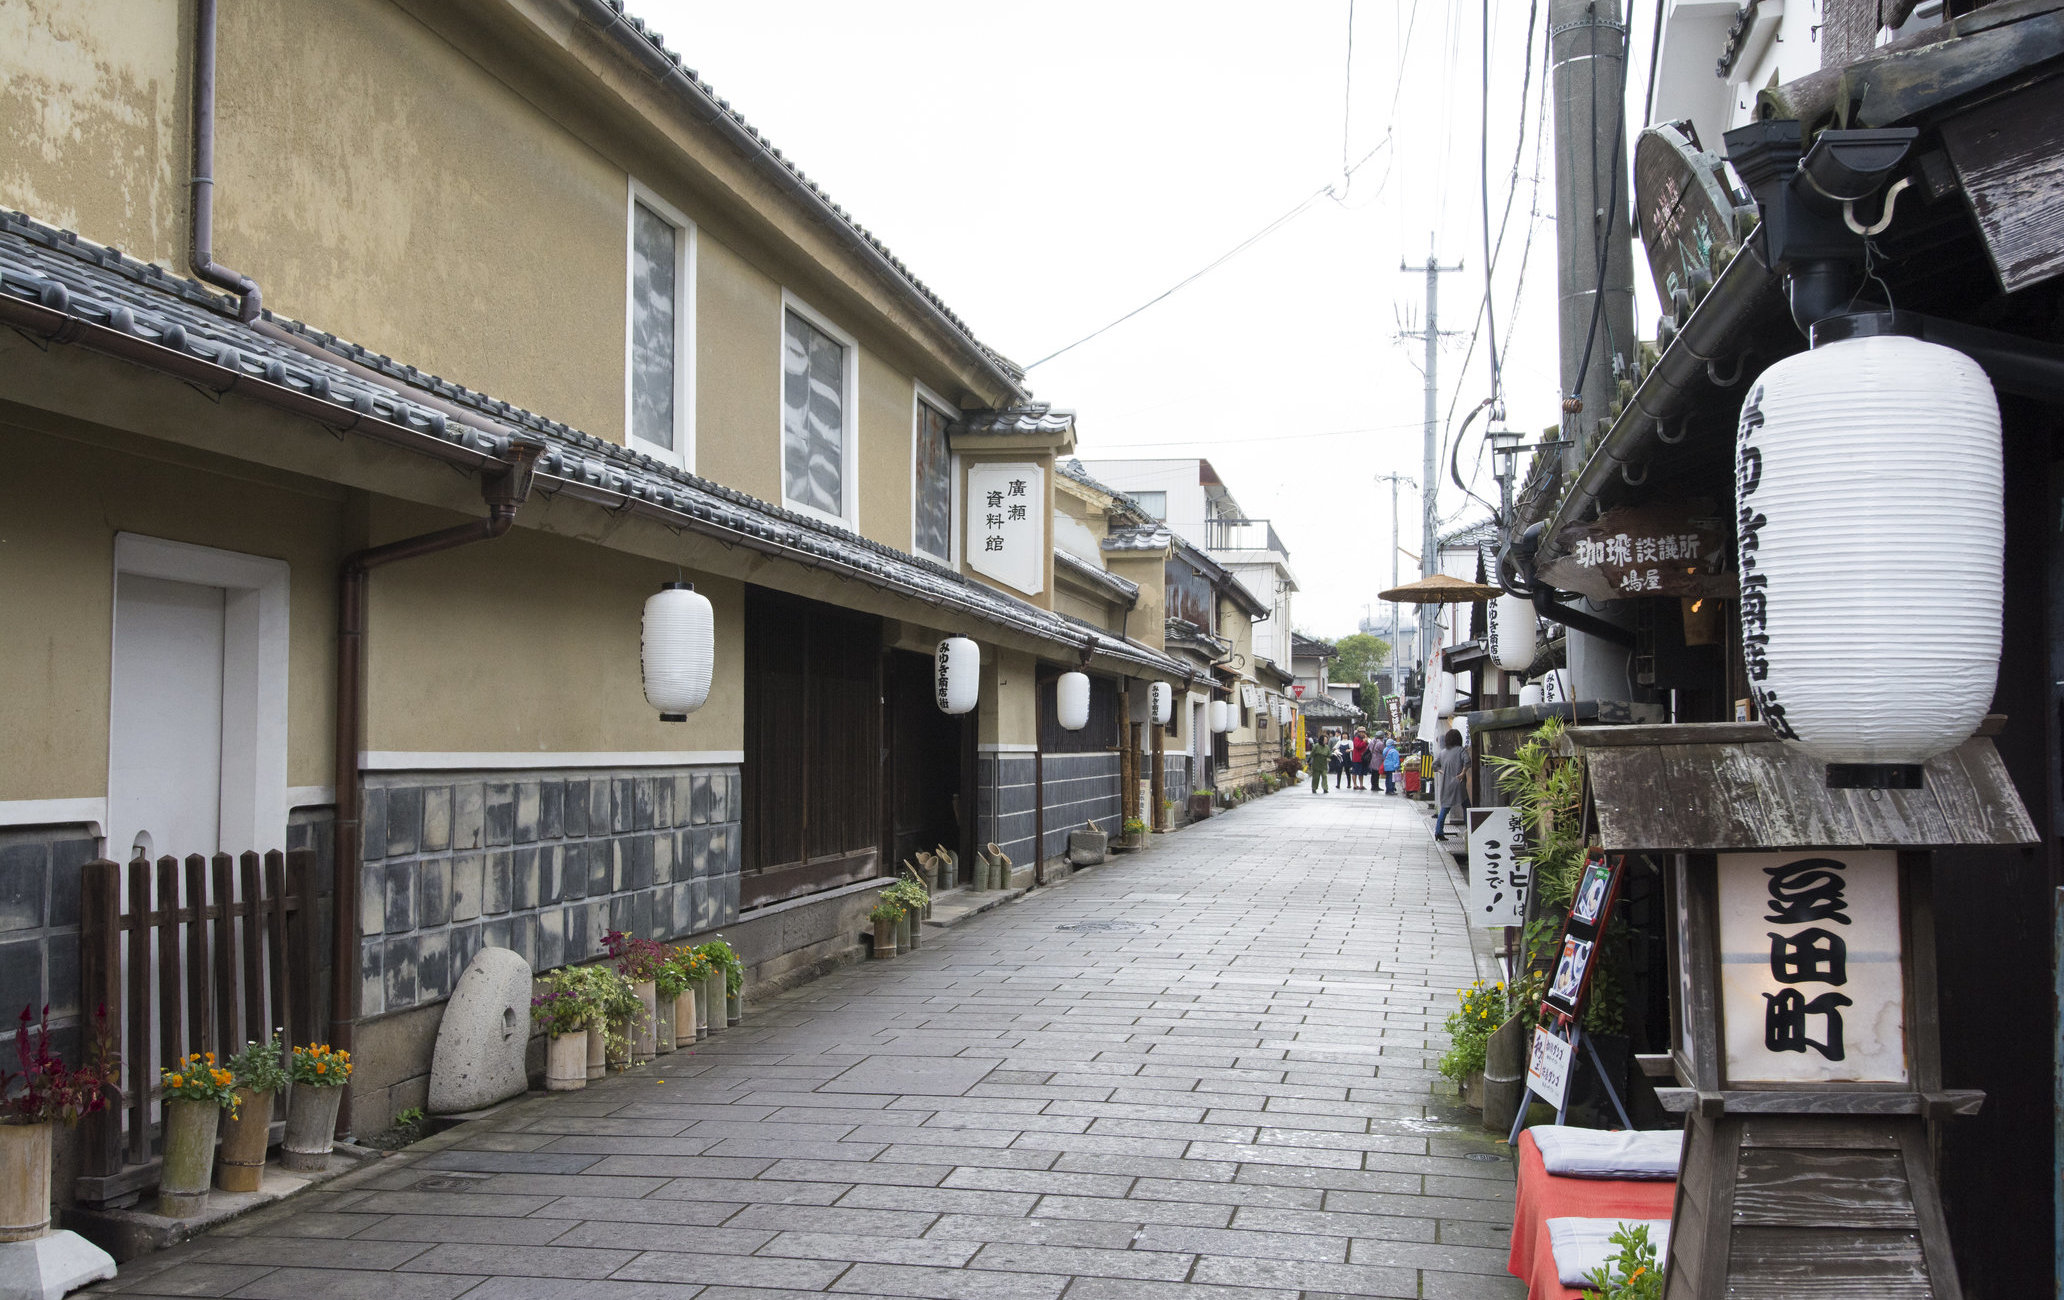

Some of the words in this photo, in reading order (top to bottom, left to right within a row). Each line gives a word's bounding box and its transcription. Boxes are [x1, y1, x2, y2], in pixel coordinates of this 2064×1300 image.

[985, 490, 1005, 552] 資料館
[1489, 598, 1502, 666] みゆき商店街
[938, 642, 950, 709] みゆき商店街
[1151, 685, 1160, 723] みゆき商店街
[1761, 857, 1853, 1062] 豆田町
